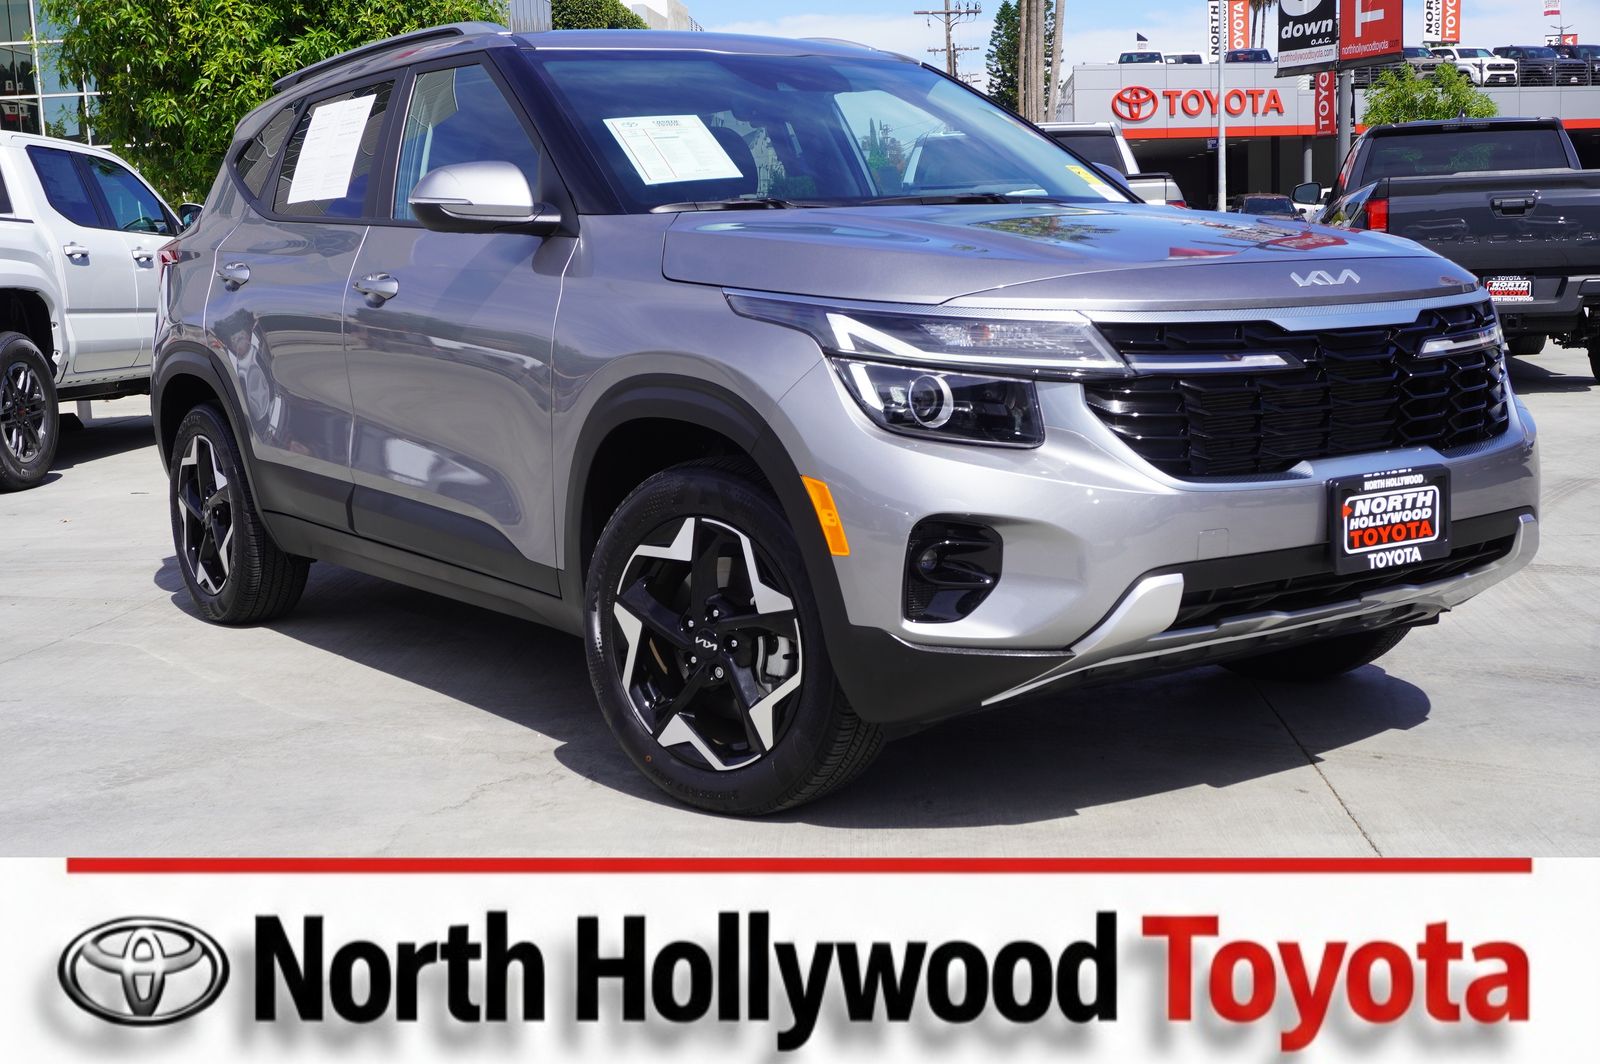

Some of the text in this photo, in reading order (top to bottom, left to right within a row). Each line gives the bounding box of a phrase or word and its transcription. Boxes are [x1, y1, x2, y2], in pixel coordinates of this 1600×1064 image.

[1211, 5, 1220, 55] NORTH
[1281, 18, 1334, 40] down
[1311, 37, 1332, 46] O.A.C.
[1163, 89, 1285, 117] TOYOTA
[1363, 473, 1424, 491] NORTH HOLLYWOOD
[1354, 490, 1434, 517] NORTH
[1349, 507, 1433, 531] HOLLYWOOD
[1349, 520, 1433, 548] TOYOTA
[1367, 546, 1422, 570] TOYOTA
